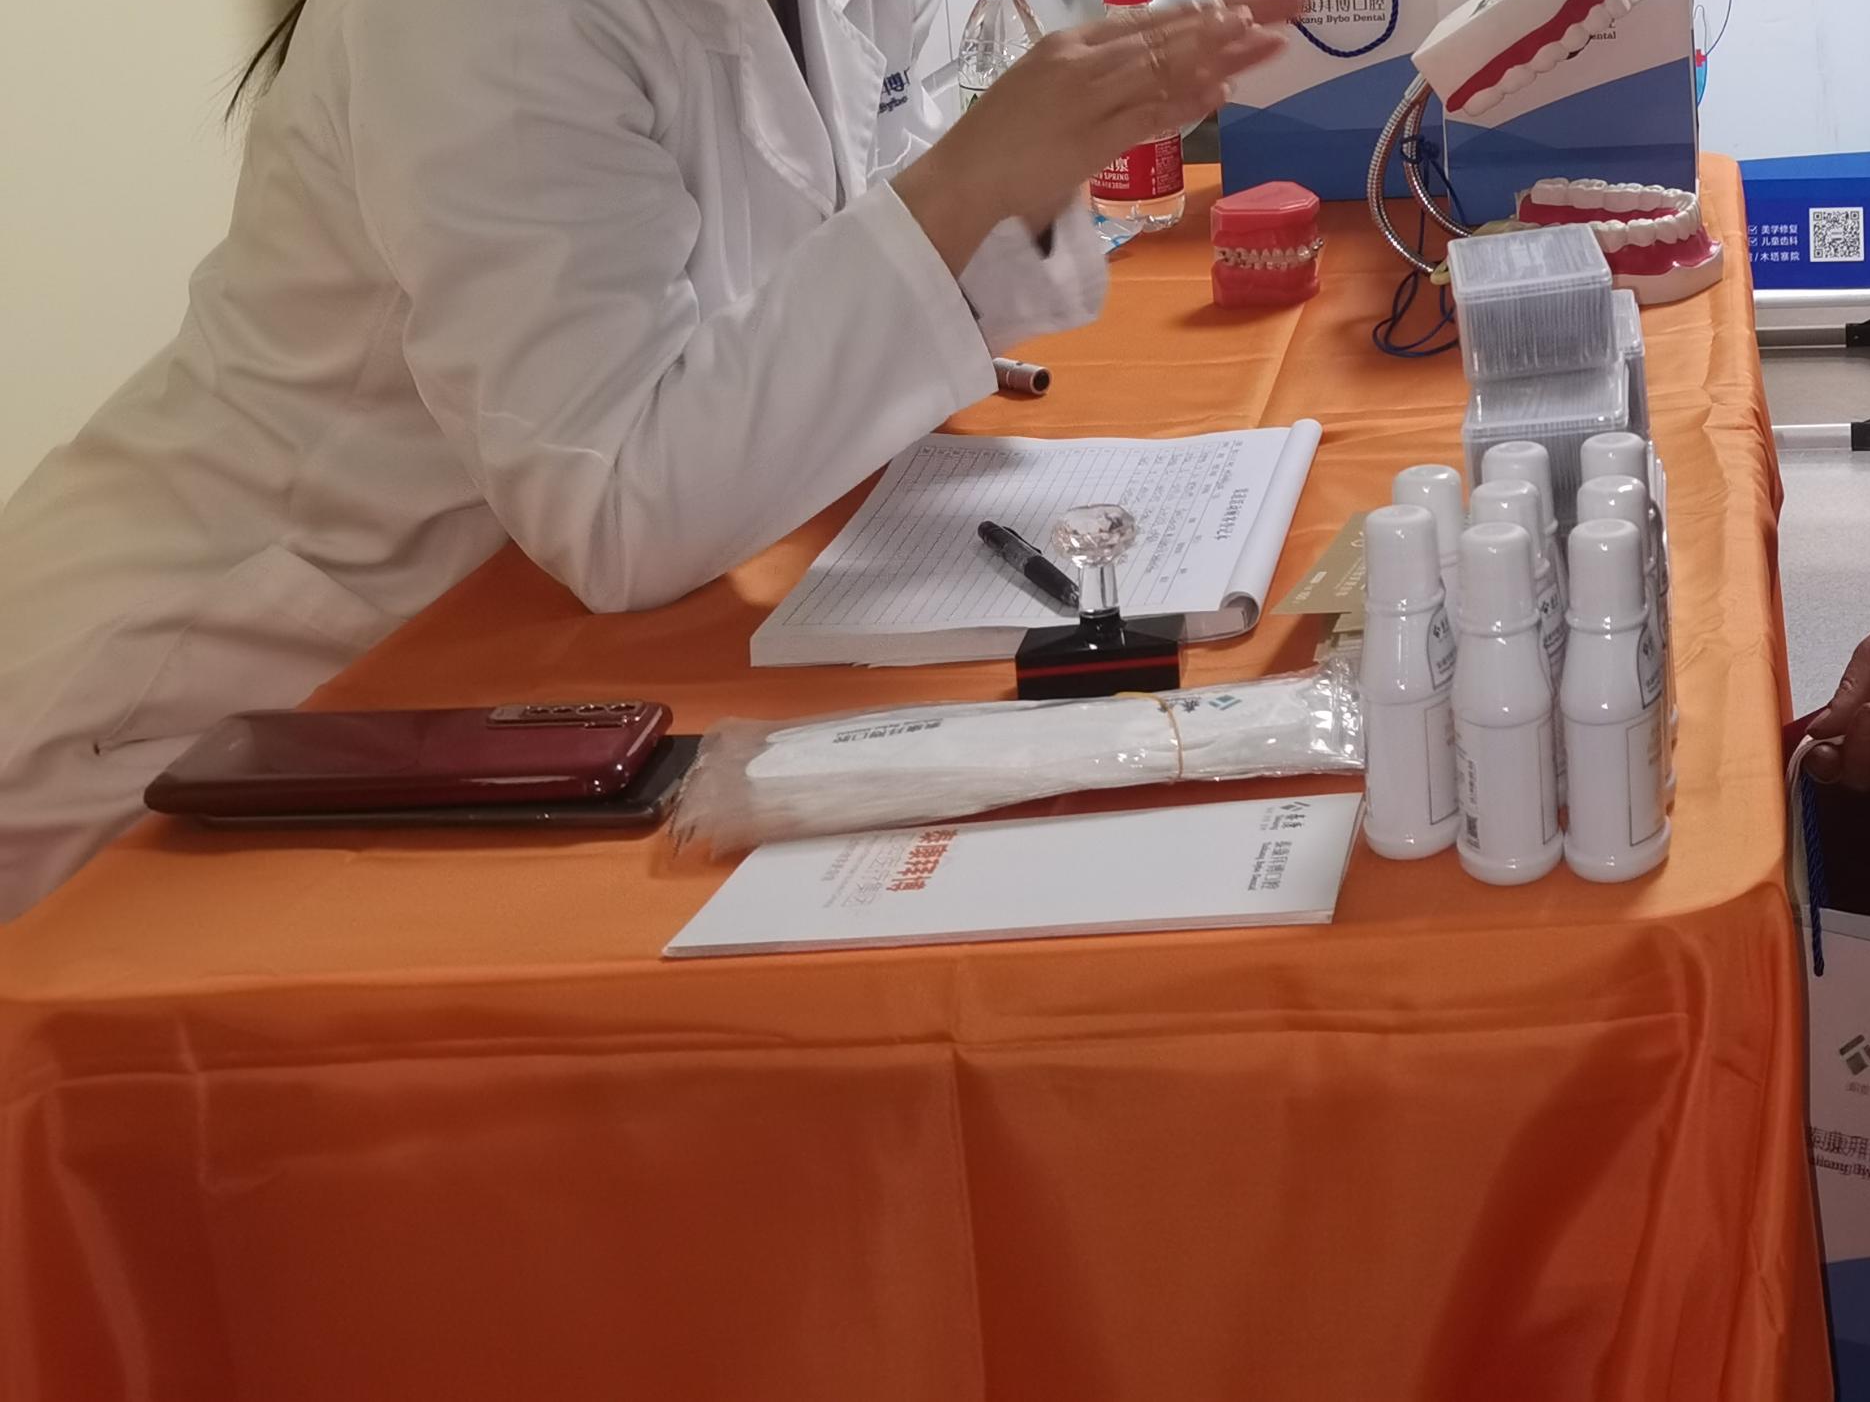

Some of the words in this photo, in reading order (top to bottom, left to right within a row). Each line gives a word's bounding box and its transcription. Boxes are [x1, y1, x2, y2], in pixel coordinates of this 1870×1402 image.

[1326, 15, 1350, 24] Bybo
[1353, 13, 1386, 22] Dental
[1591, 31, 1617, 40] ental
[1749, 251, 1800, 262] /木塔寨院
